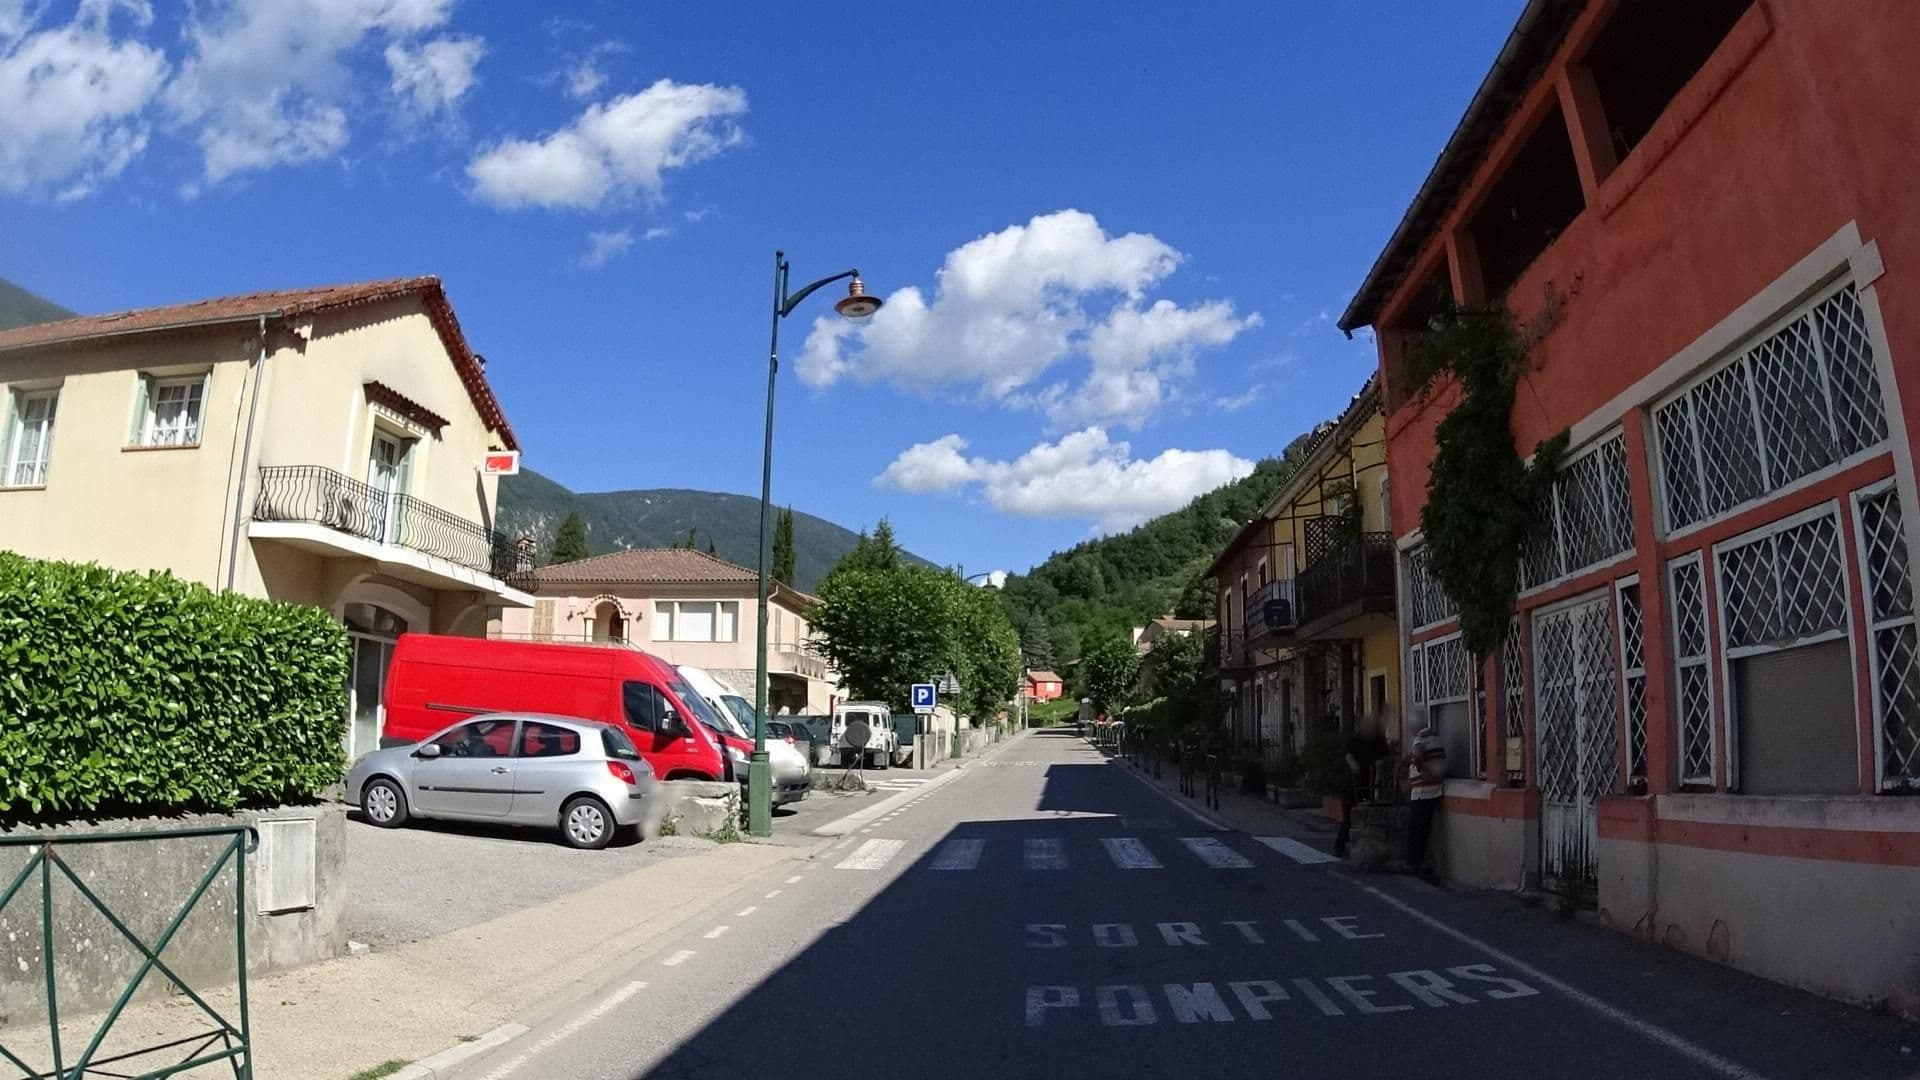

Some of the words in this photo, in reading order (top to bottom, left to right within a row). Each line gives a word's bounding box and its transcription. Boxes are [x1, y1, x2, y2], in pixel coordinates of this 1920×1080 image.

[918, 689, 929, 703] P
[1025, 916, 1386, 948] SORTIE
[1024, 963, 1541, 1028] POMPIERS
